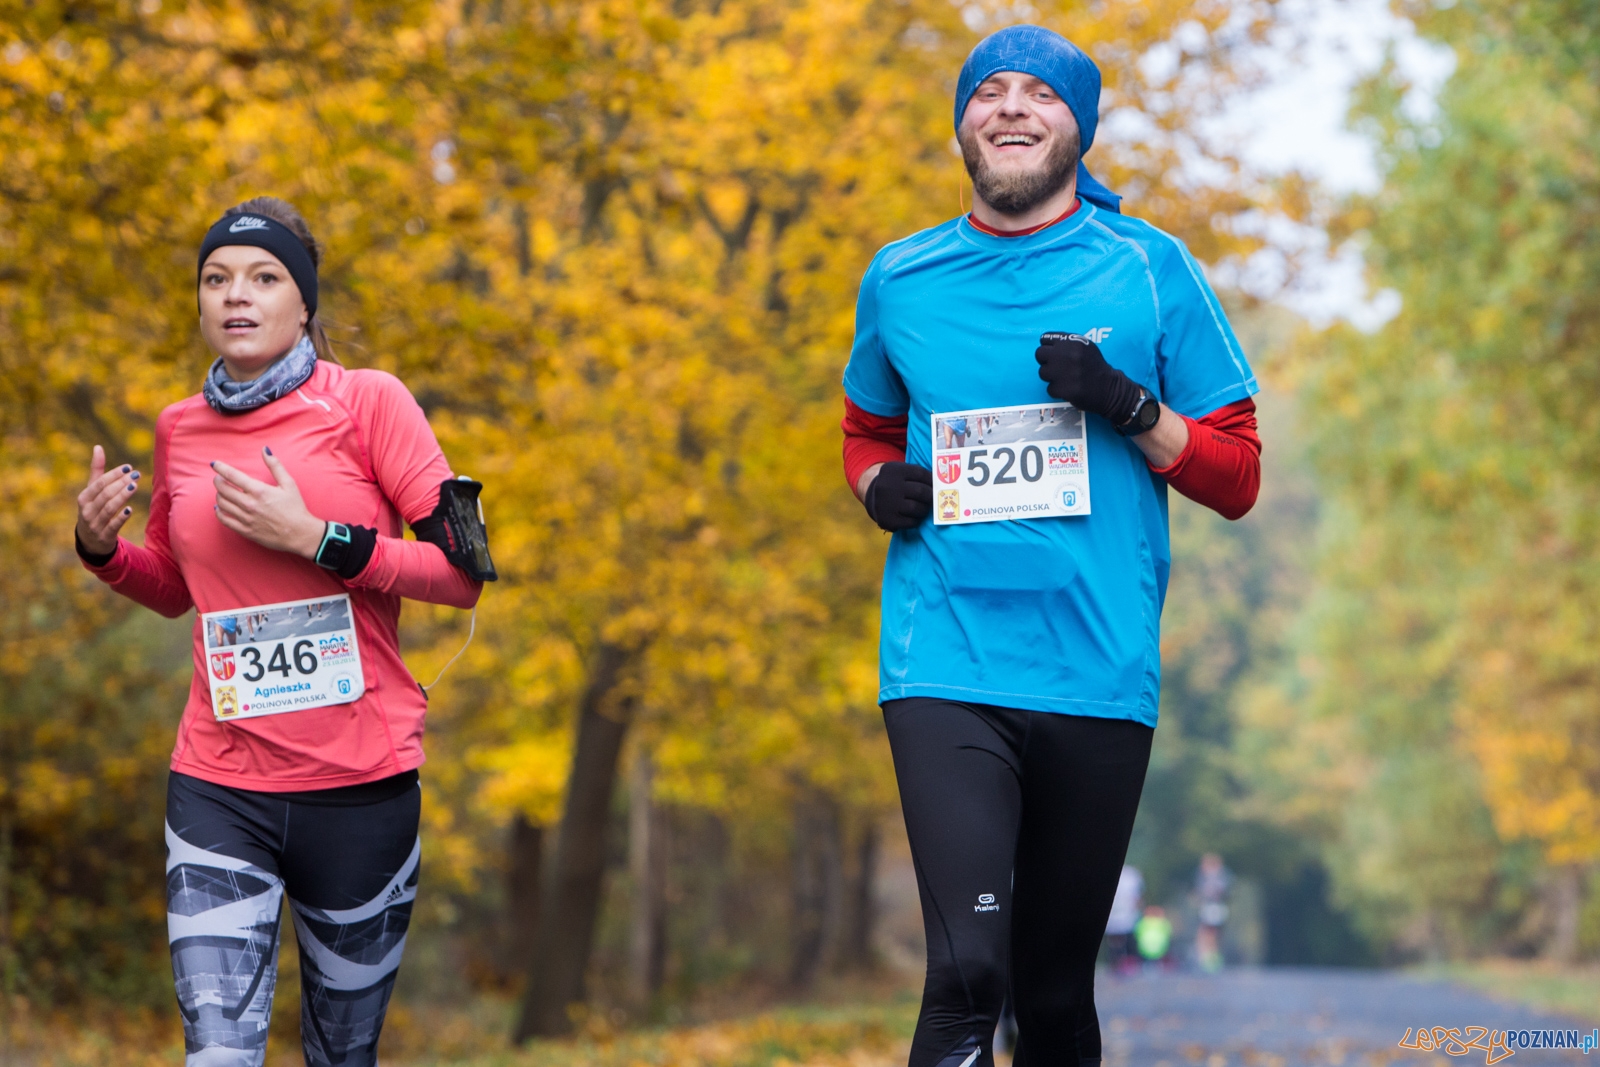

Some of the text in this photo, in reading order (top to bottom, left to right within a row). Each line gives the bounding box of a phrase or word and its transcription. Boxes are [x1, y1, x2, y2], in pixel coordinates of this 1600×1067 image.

[237, 216, 267, 228] RUN
[1048, 451, 1079, 459] MARATON
[967, 445, 1044, 487] 520
[972, 505, 1015, 516] POLINOVA
[1016, 503, 1050, 512] POLSKA
[240, 639, 318, 682] 346
[254, 682, 311, 698] Agnieszka
[251, 698, 293, 710] POLINOVA
[294, 693, 327, 704] POLSKA
